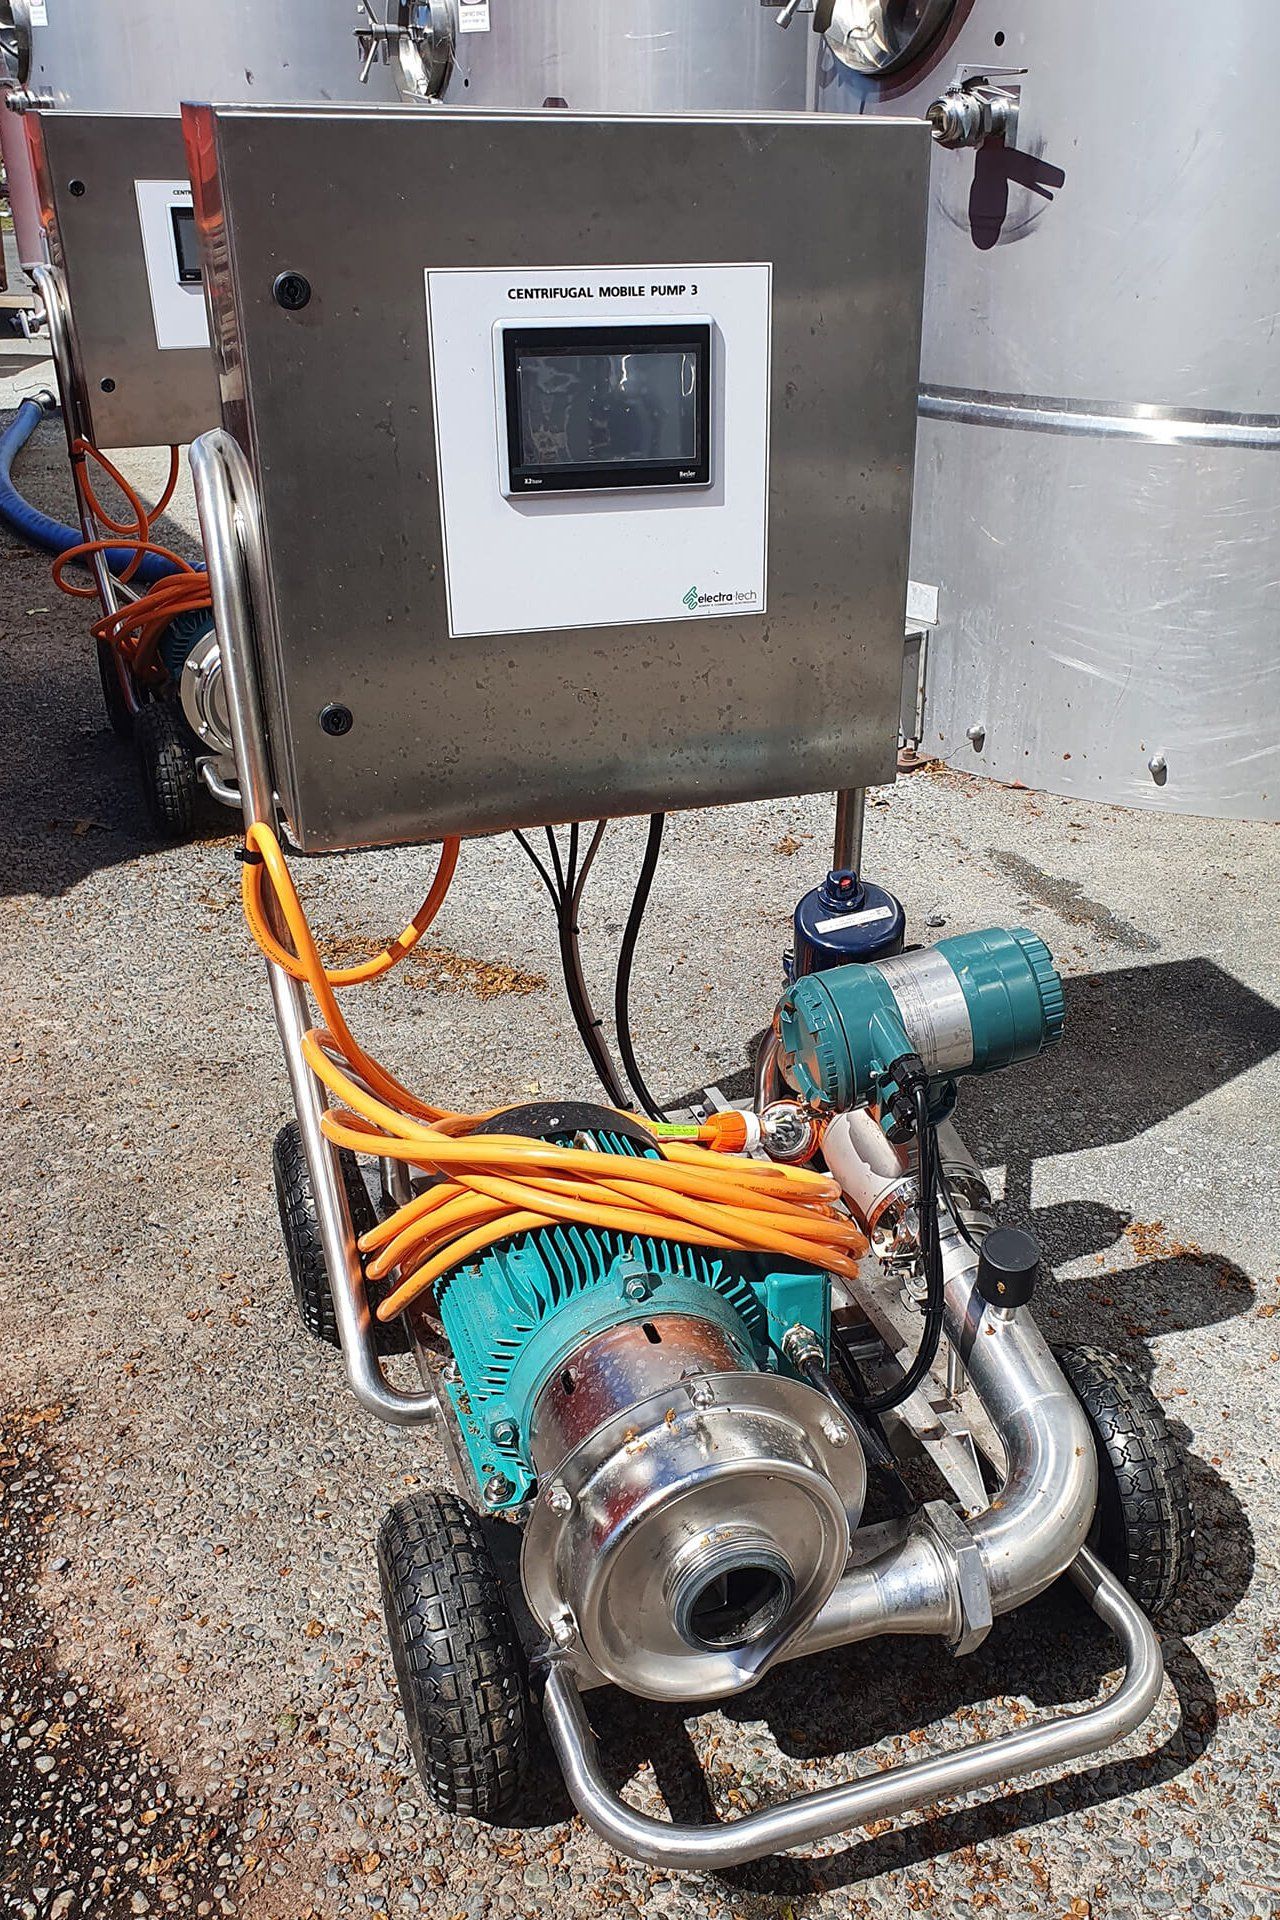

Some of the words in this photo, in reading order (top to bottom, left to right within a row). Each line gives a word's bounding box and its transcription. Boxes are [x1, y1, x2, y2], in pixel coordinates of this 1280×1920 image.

[507, 287, 594, 300] CENTRIFUGAL
[599, 286, 645, 298] MOBILE
[651, 285, 686, 297] PUMP
[691, 284, 698, 296] 3
